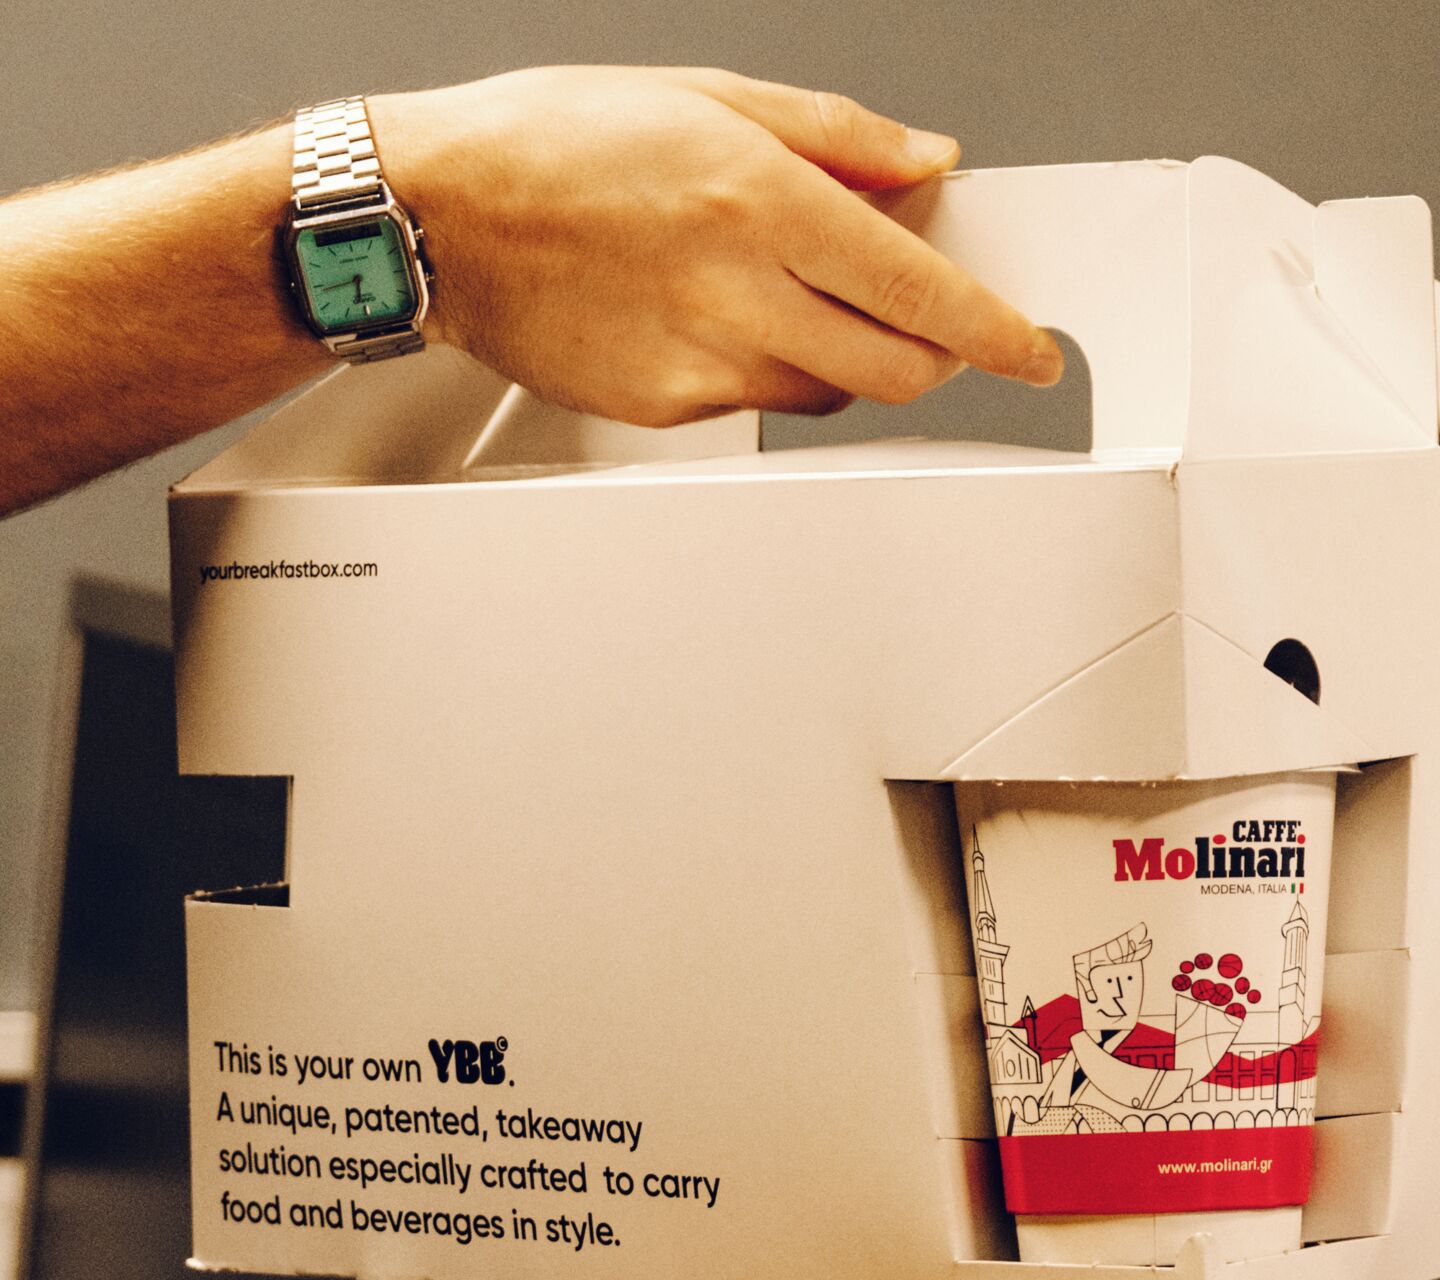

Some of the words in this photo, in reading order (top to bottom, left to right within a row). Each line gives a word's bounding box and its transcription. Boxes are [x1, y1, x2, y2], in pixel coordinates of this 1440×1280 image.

[200, 559, 378, 586] yourbreakfastbox.com
[1112, 833, 1306, 882] Molinari
[1200, 883, 1255, 896] MODENA,
[1258, 882, 1287, 894] ITALIA
[213, 1040, 262, 1076] This
[267, 1044, 288, 1077] is
[294, 1054, 355, 1086] your
[362, 1057, 422, 1083] own
[216, 1091, 235, 1123] A
[240, 1094, 337, 1135] unique,
[344, 1104, 488, 1142] patented,
[495, 1107, 643, 1152] takeaway
[219, 1141, 322, 1179] solution
[328, 1152, 472, 1194] especially
[480, 1158, 588, 1193] crafted
[602, 1165, 635, 1196] to
[642, 1173, 721, 1209] carry
[1157, 1157, 1273, 1174] www.molinari.gr
[220, 1190, 282, 1226] food
[289, 1198, 344, 1230] and
[350, 1199, 505, 1246] beverages
[512, 1208, 538, 1241] in
[545, 1212, 621, 1252] style.
